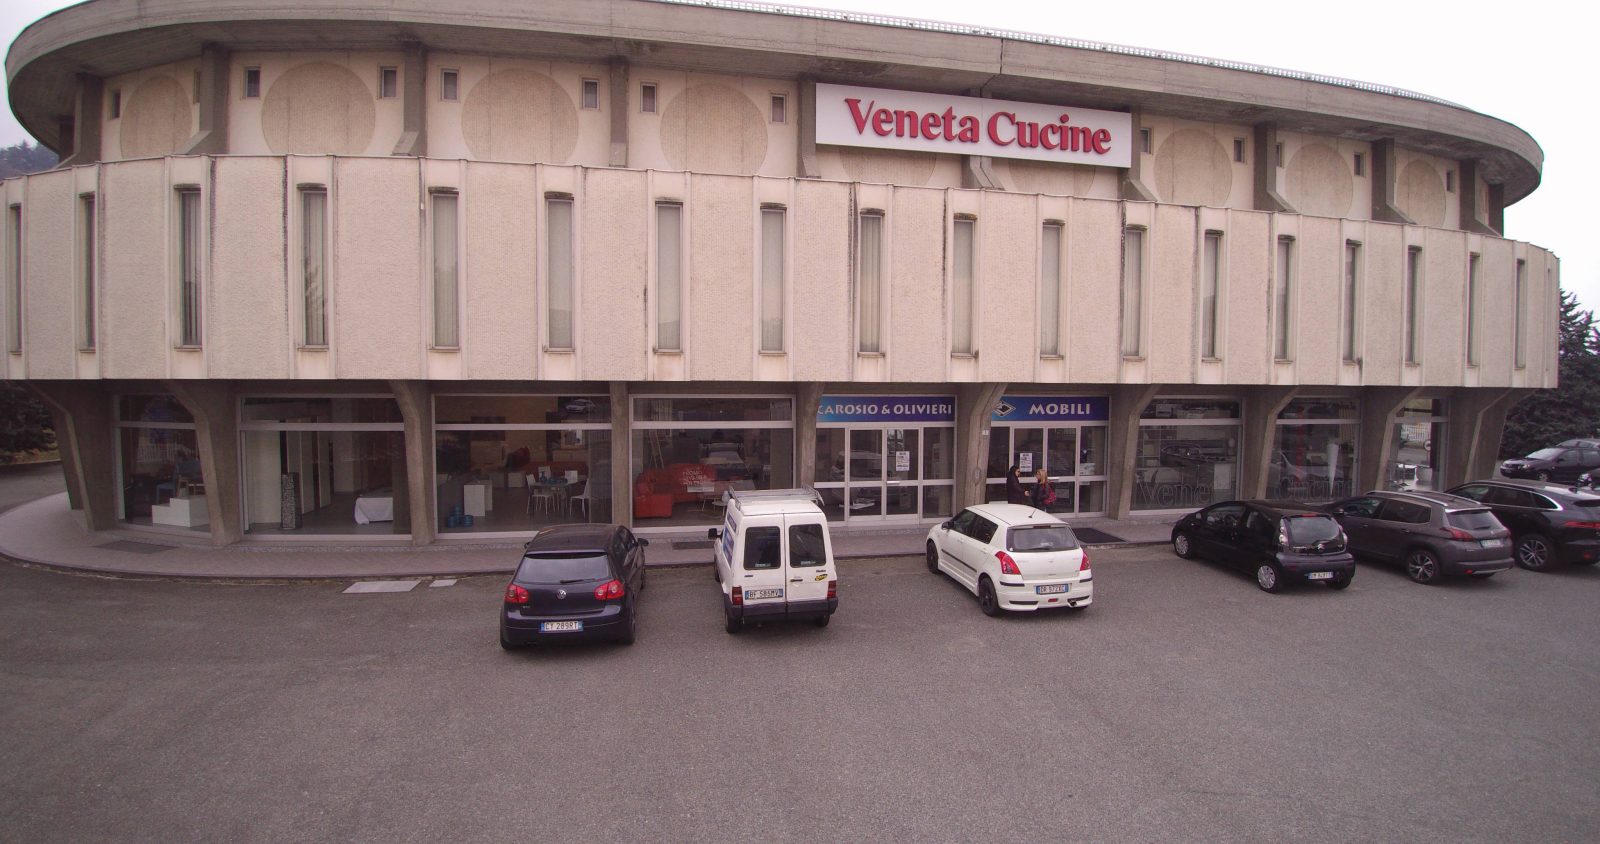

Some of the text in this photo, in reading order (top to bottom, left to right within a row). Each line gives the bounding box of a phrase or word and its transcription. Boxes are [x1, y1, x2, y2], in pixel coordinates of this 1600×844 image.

[844, 97, 1112, 155] Veneta Cucine
[817, 404, 952, 415] CAROSIO & OLIVIERI
[1028, 403, 1091, 415] MOBILI
